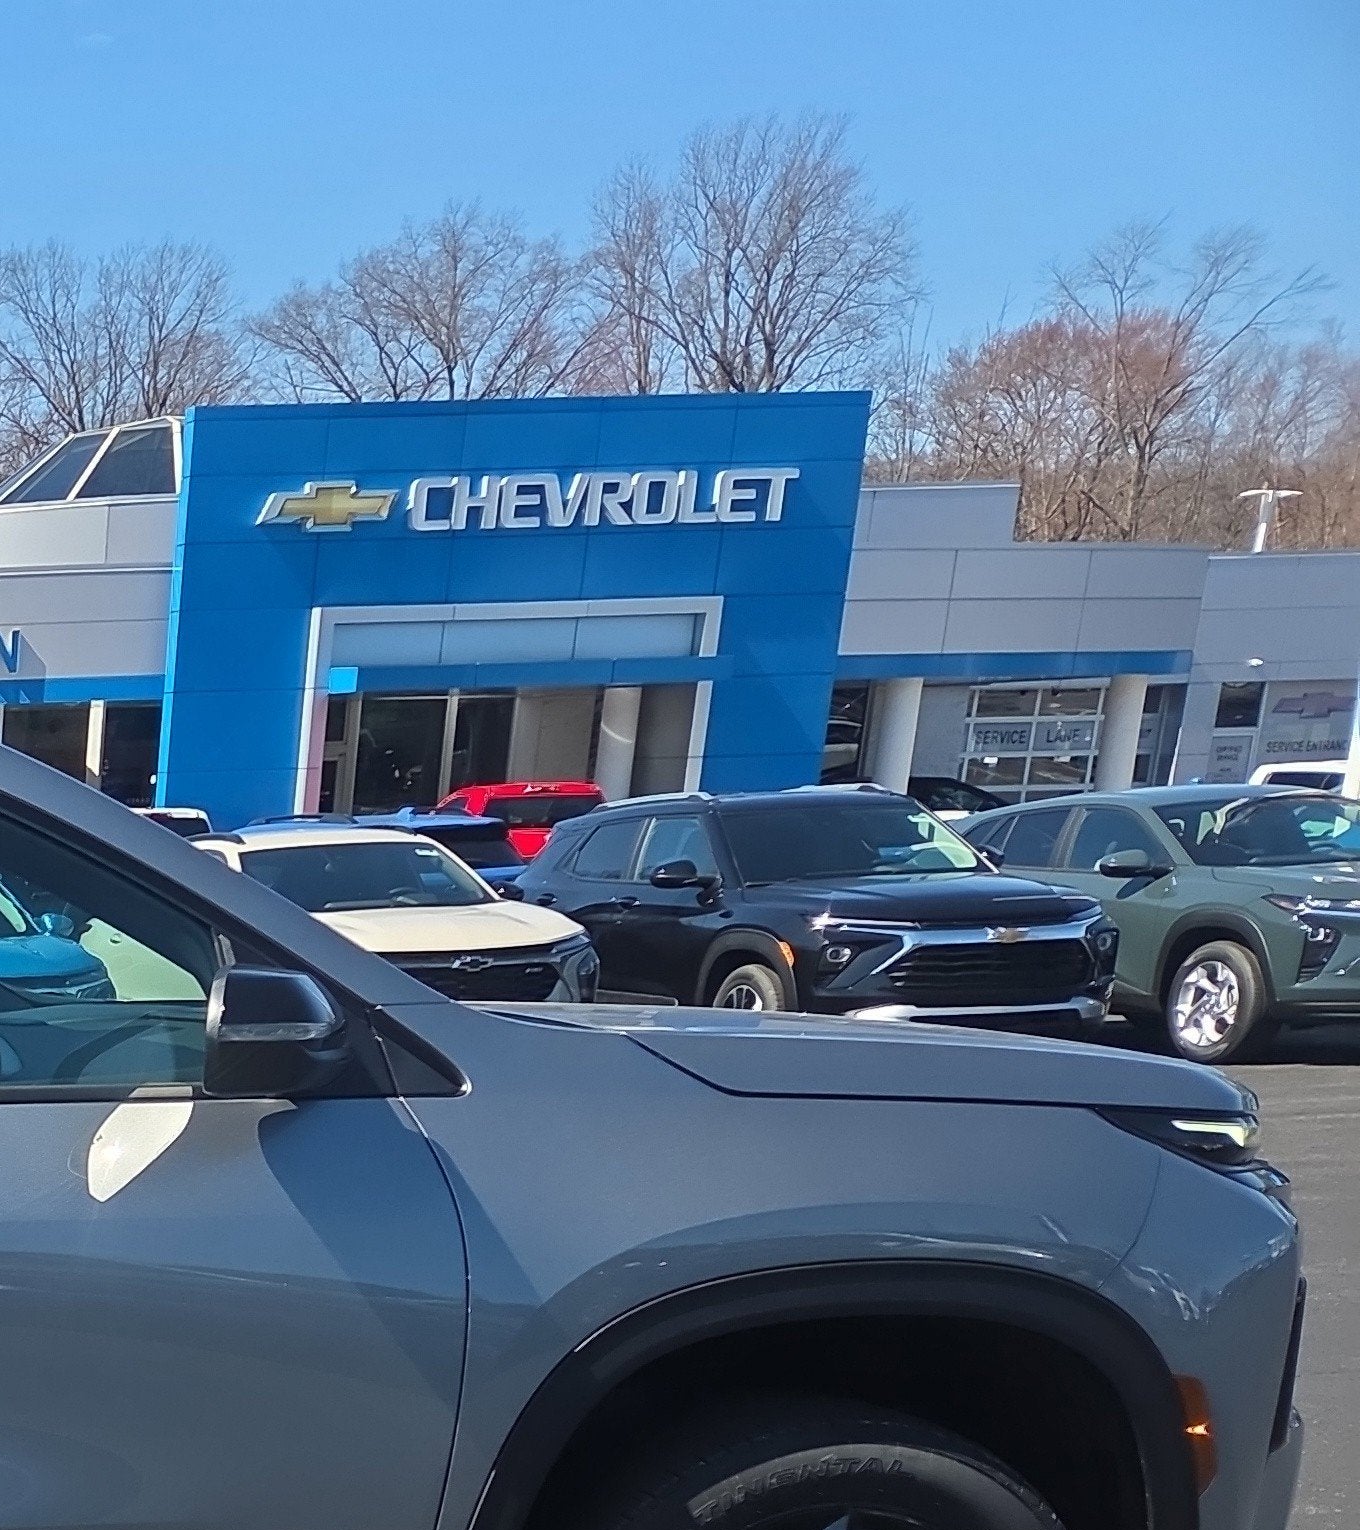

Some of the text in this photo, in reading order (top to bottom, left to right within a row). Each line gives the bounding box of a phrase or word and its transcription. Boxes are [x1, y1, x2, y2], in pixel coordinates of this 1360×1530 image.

[406, 468, 800, 531] CHEVROLET
[975, 729, 1081, 744] SERVICE LANE
[1266, 739, 1349, 753] SERVICE ENTRANC
